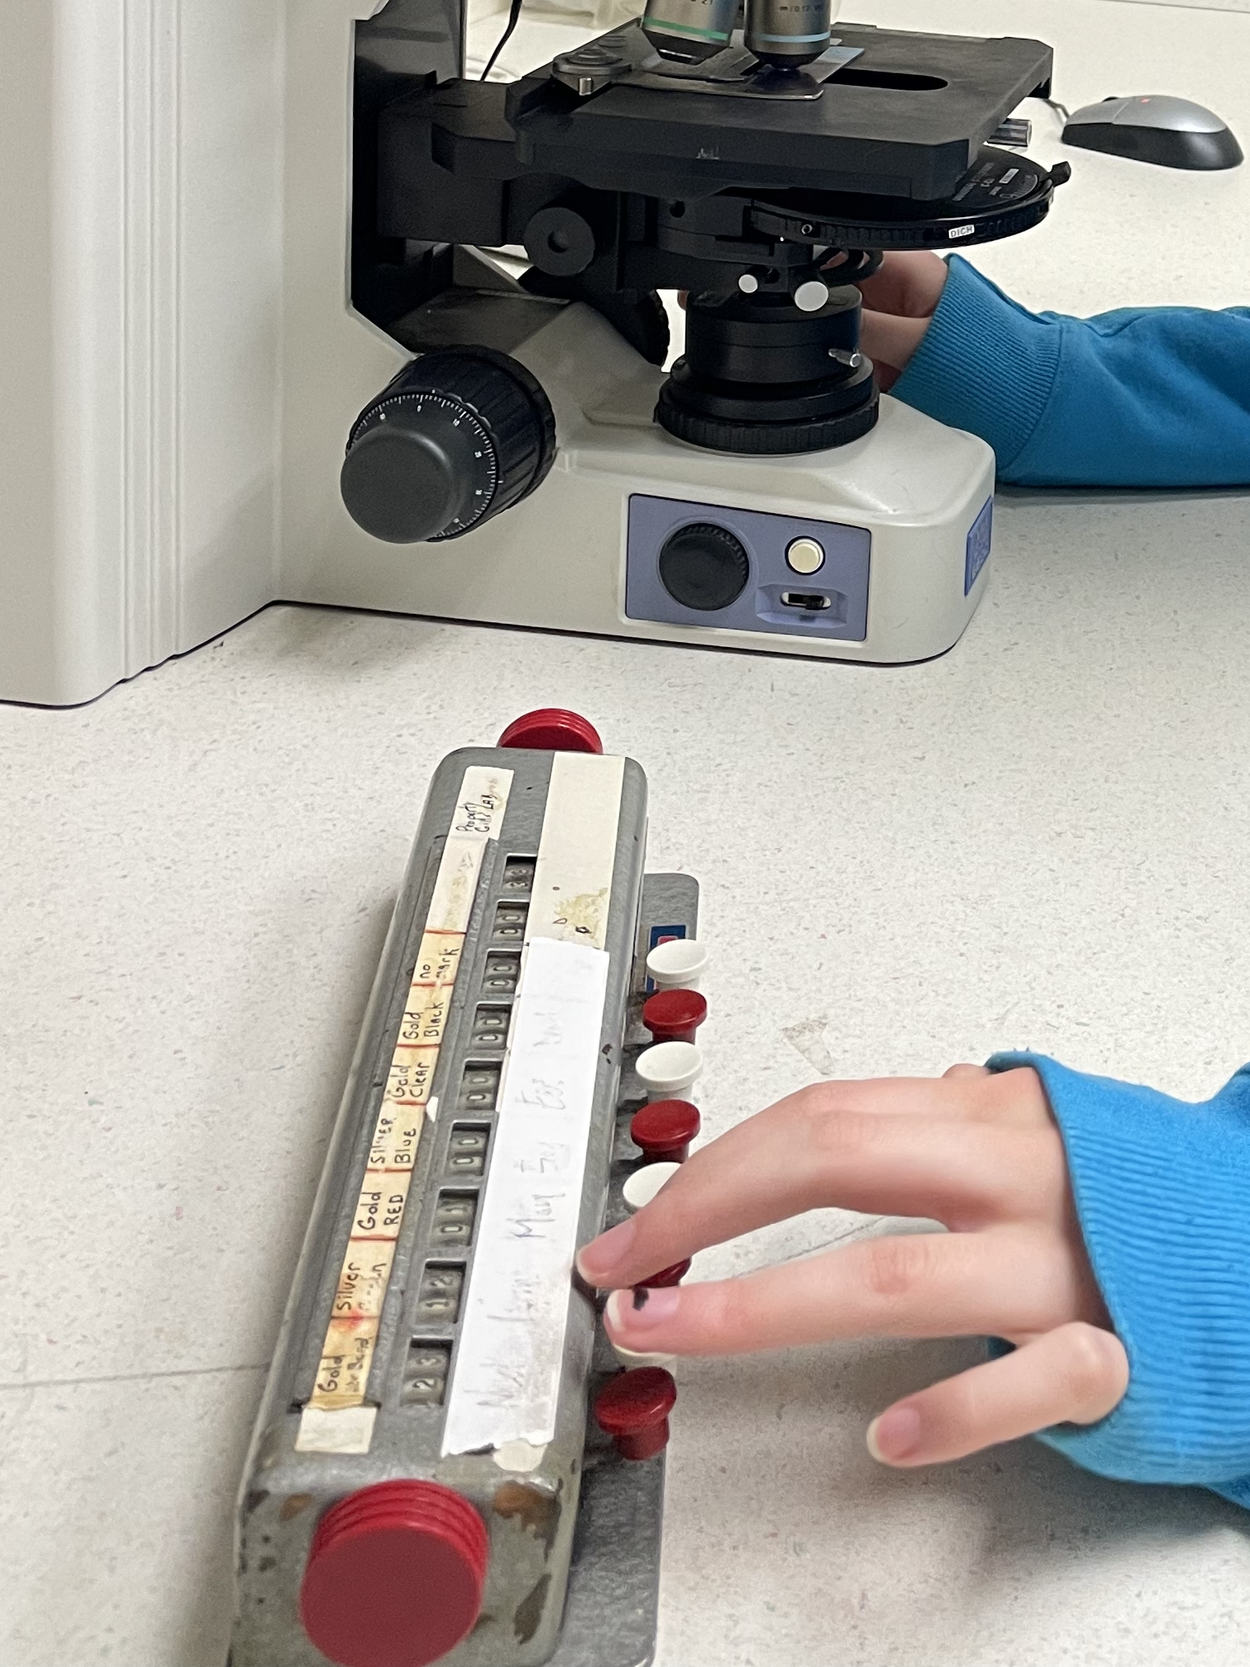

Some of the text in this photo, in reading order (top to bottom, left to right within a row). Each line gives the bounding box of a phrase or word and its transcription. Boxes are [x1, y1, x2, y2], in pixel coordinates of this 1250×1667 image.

[419, 963, 432, 980] no
[402, 1011, 425, 1040] Gold
[389, 1064, 412, 1098] Gold
[357, 1191, 382, 1231] Gold
[383, 1194, 404, 1226] RED
[336, 1262, 361, 1311] Silver
[317, 1354, 346, 1392] Gold
